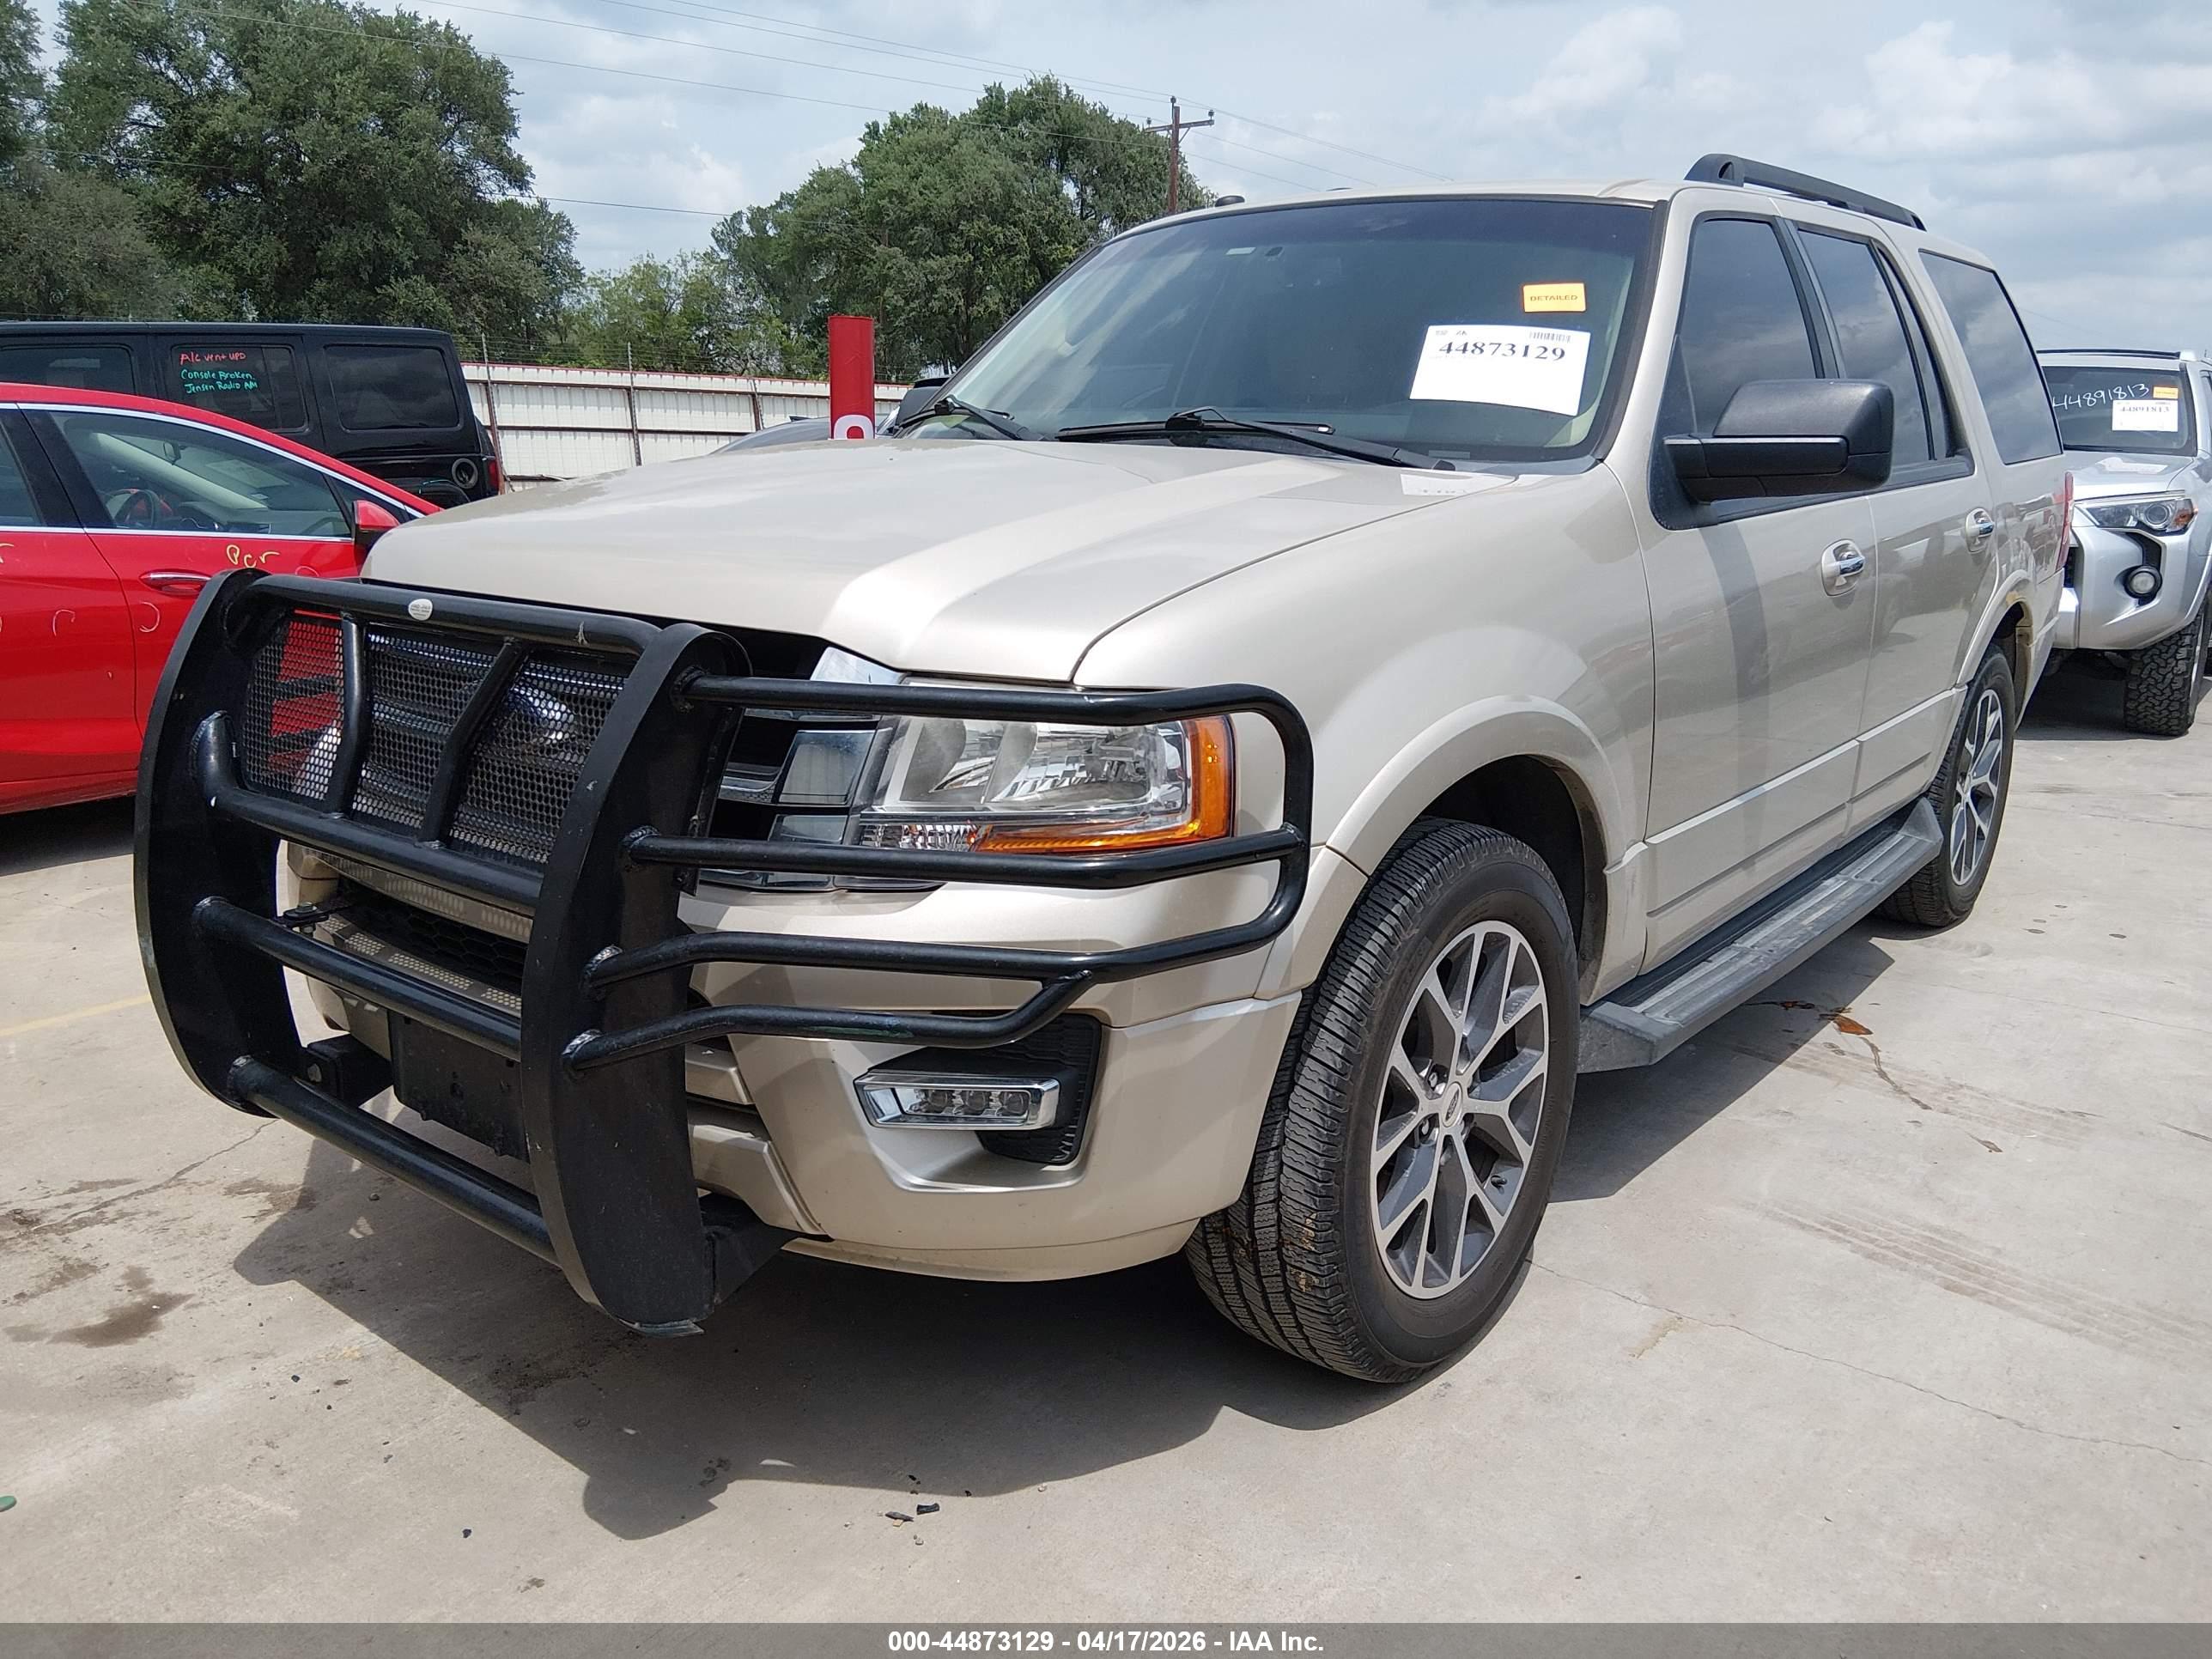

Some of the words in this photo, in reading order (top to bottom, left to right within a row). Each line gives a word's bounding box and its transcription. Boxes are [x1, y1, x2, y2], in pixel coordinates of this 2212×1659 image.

[1438, 341, 1565, 362] 44873129
[180, 368, 216, 380] Console
[184, 382, 215, 394] Jensen
[2052, 383, 2150, 410] 44891813
